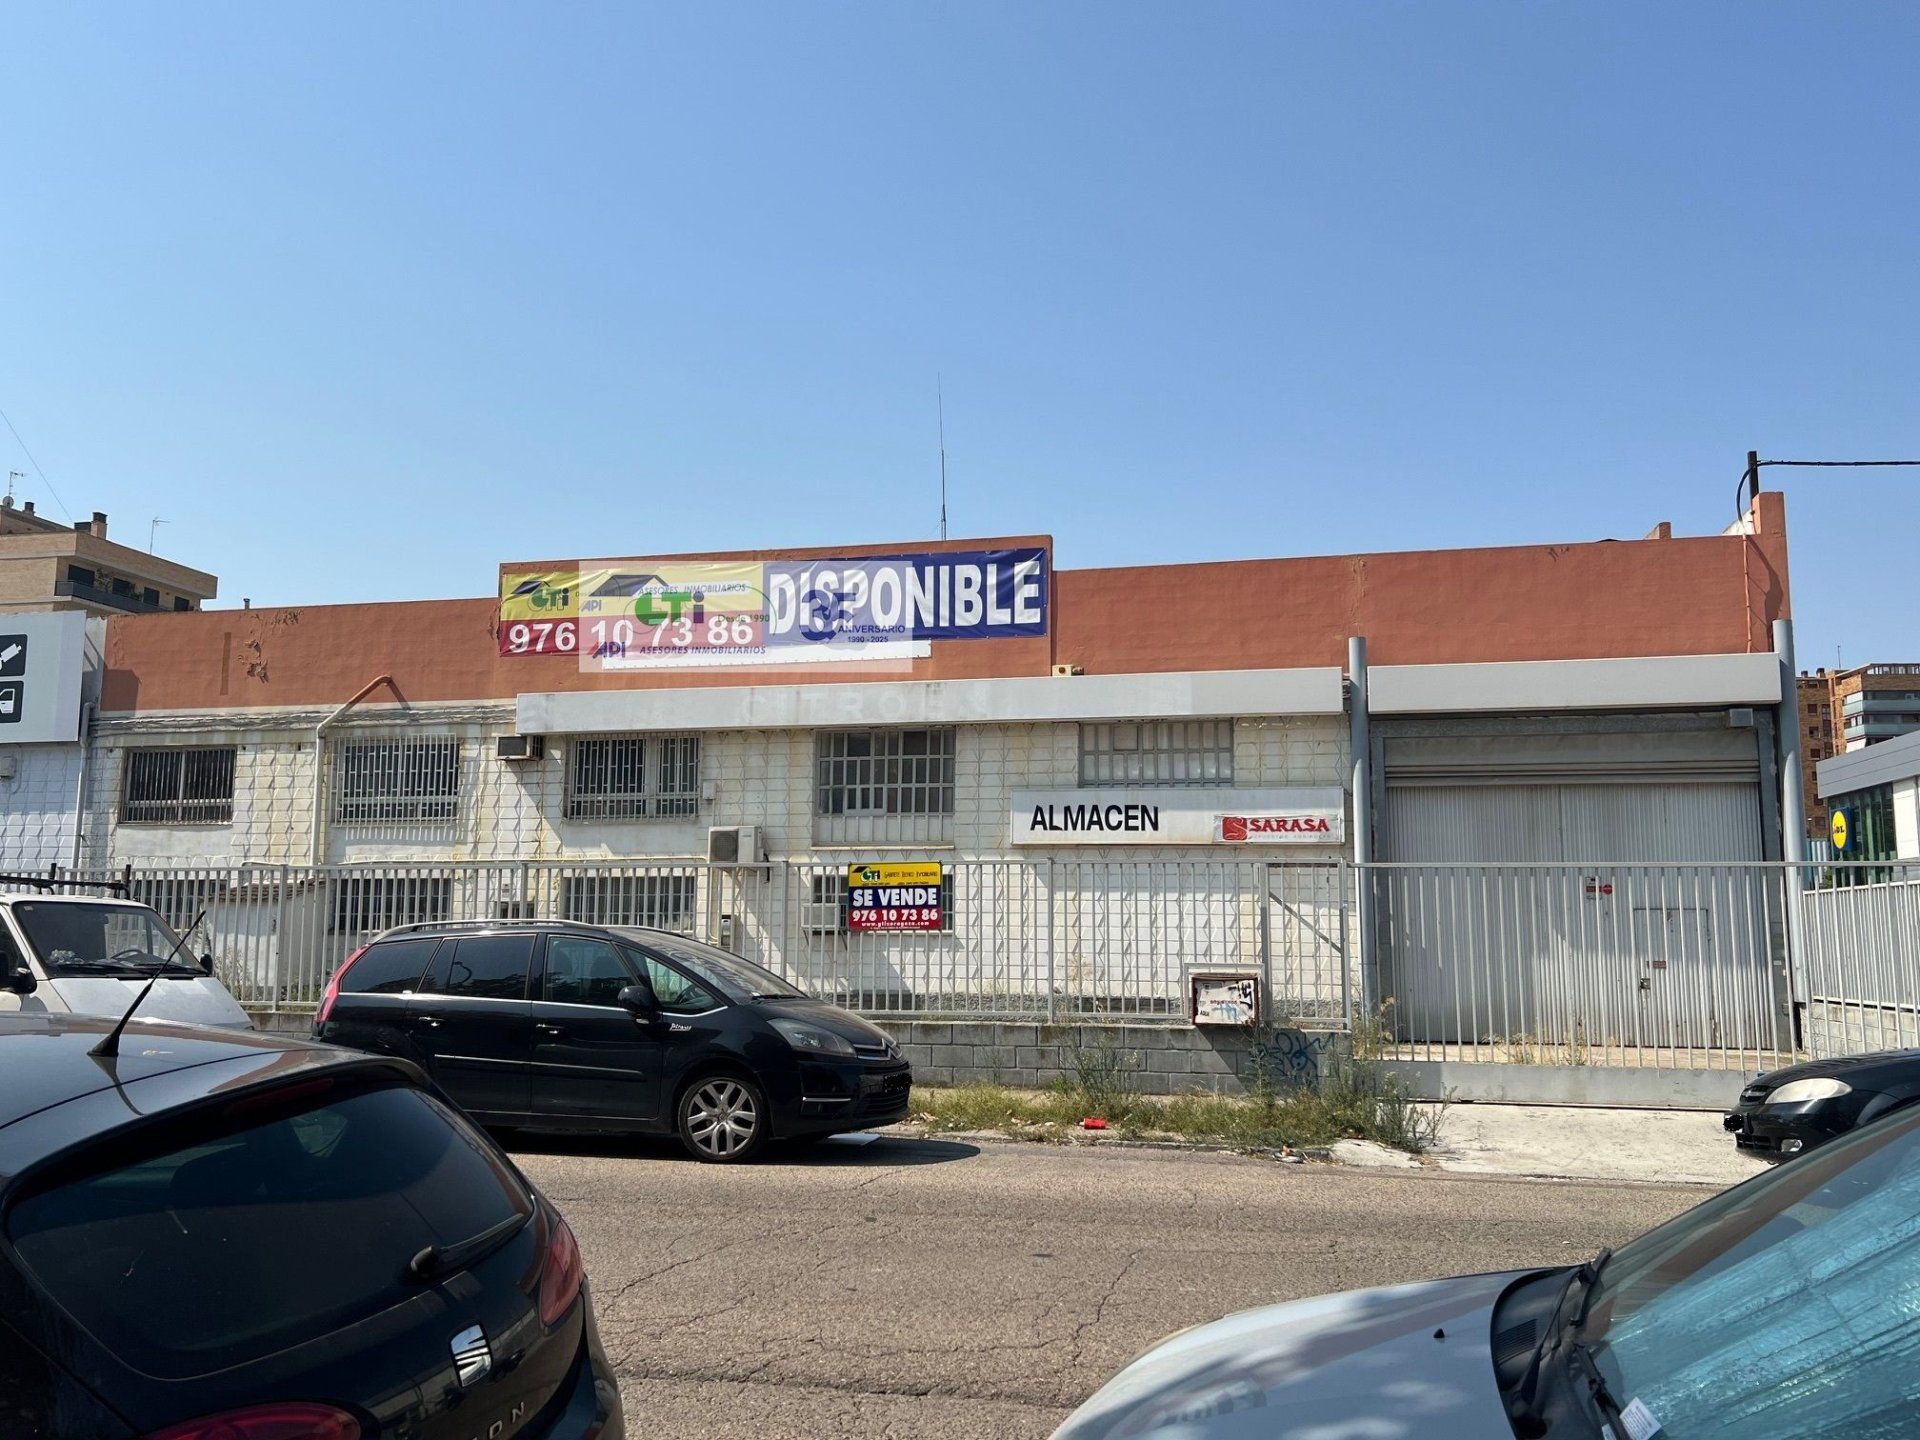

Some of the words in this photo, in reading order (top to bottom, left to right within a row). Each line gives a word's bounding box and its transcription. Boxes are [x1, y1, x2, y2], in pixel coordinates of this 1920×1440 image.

[769, 561, 1041, 634] DISPONIBLE
[509, 622, 576, 653] 976
[591, 619, 632, 652] 10
[648, 616, 693, 648] 73
[707, 614, 753, 646] 86
[1030, 804, 1159, 832] ALMACEN
[1249, 817, 1330, 832] SARASA
[852, 889, 873, 907] SE
[878, 887, 937, 906] VENDE
[852, 910, 877, 922] 976
[882, 909, 897, 921] 10
[901, 909, 917, 921] 73
[921, 908, 938, 921] 86
